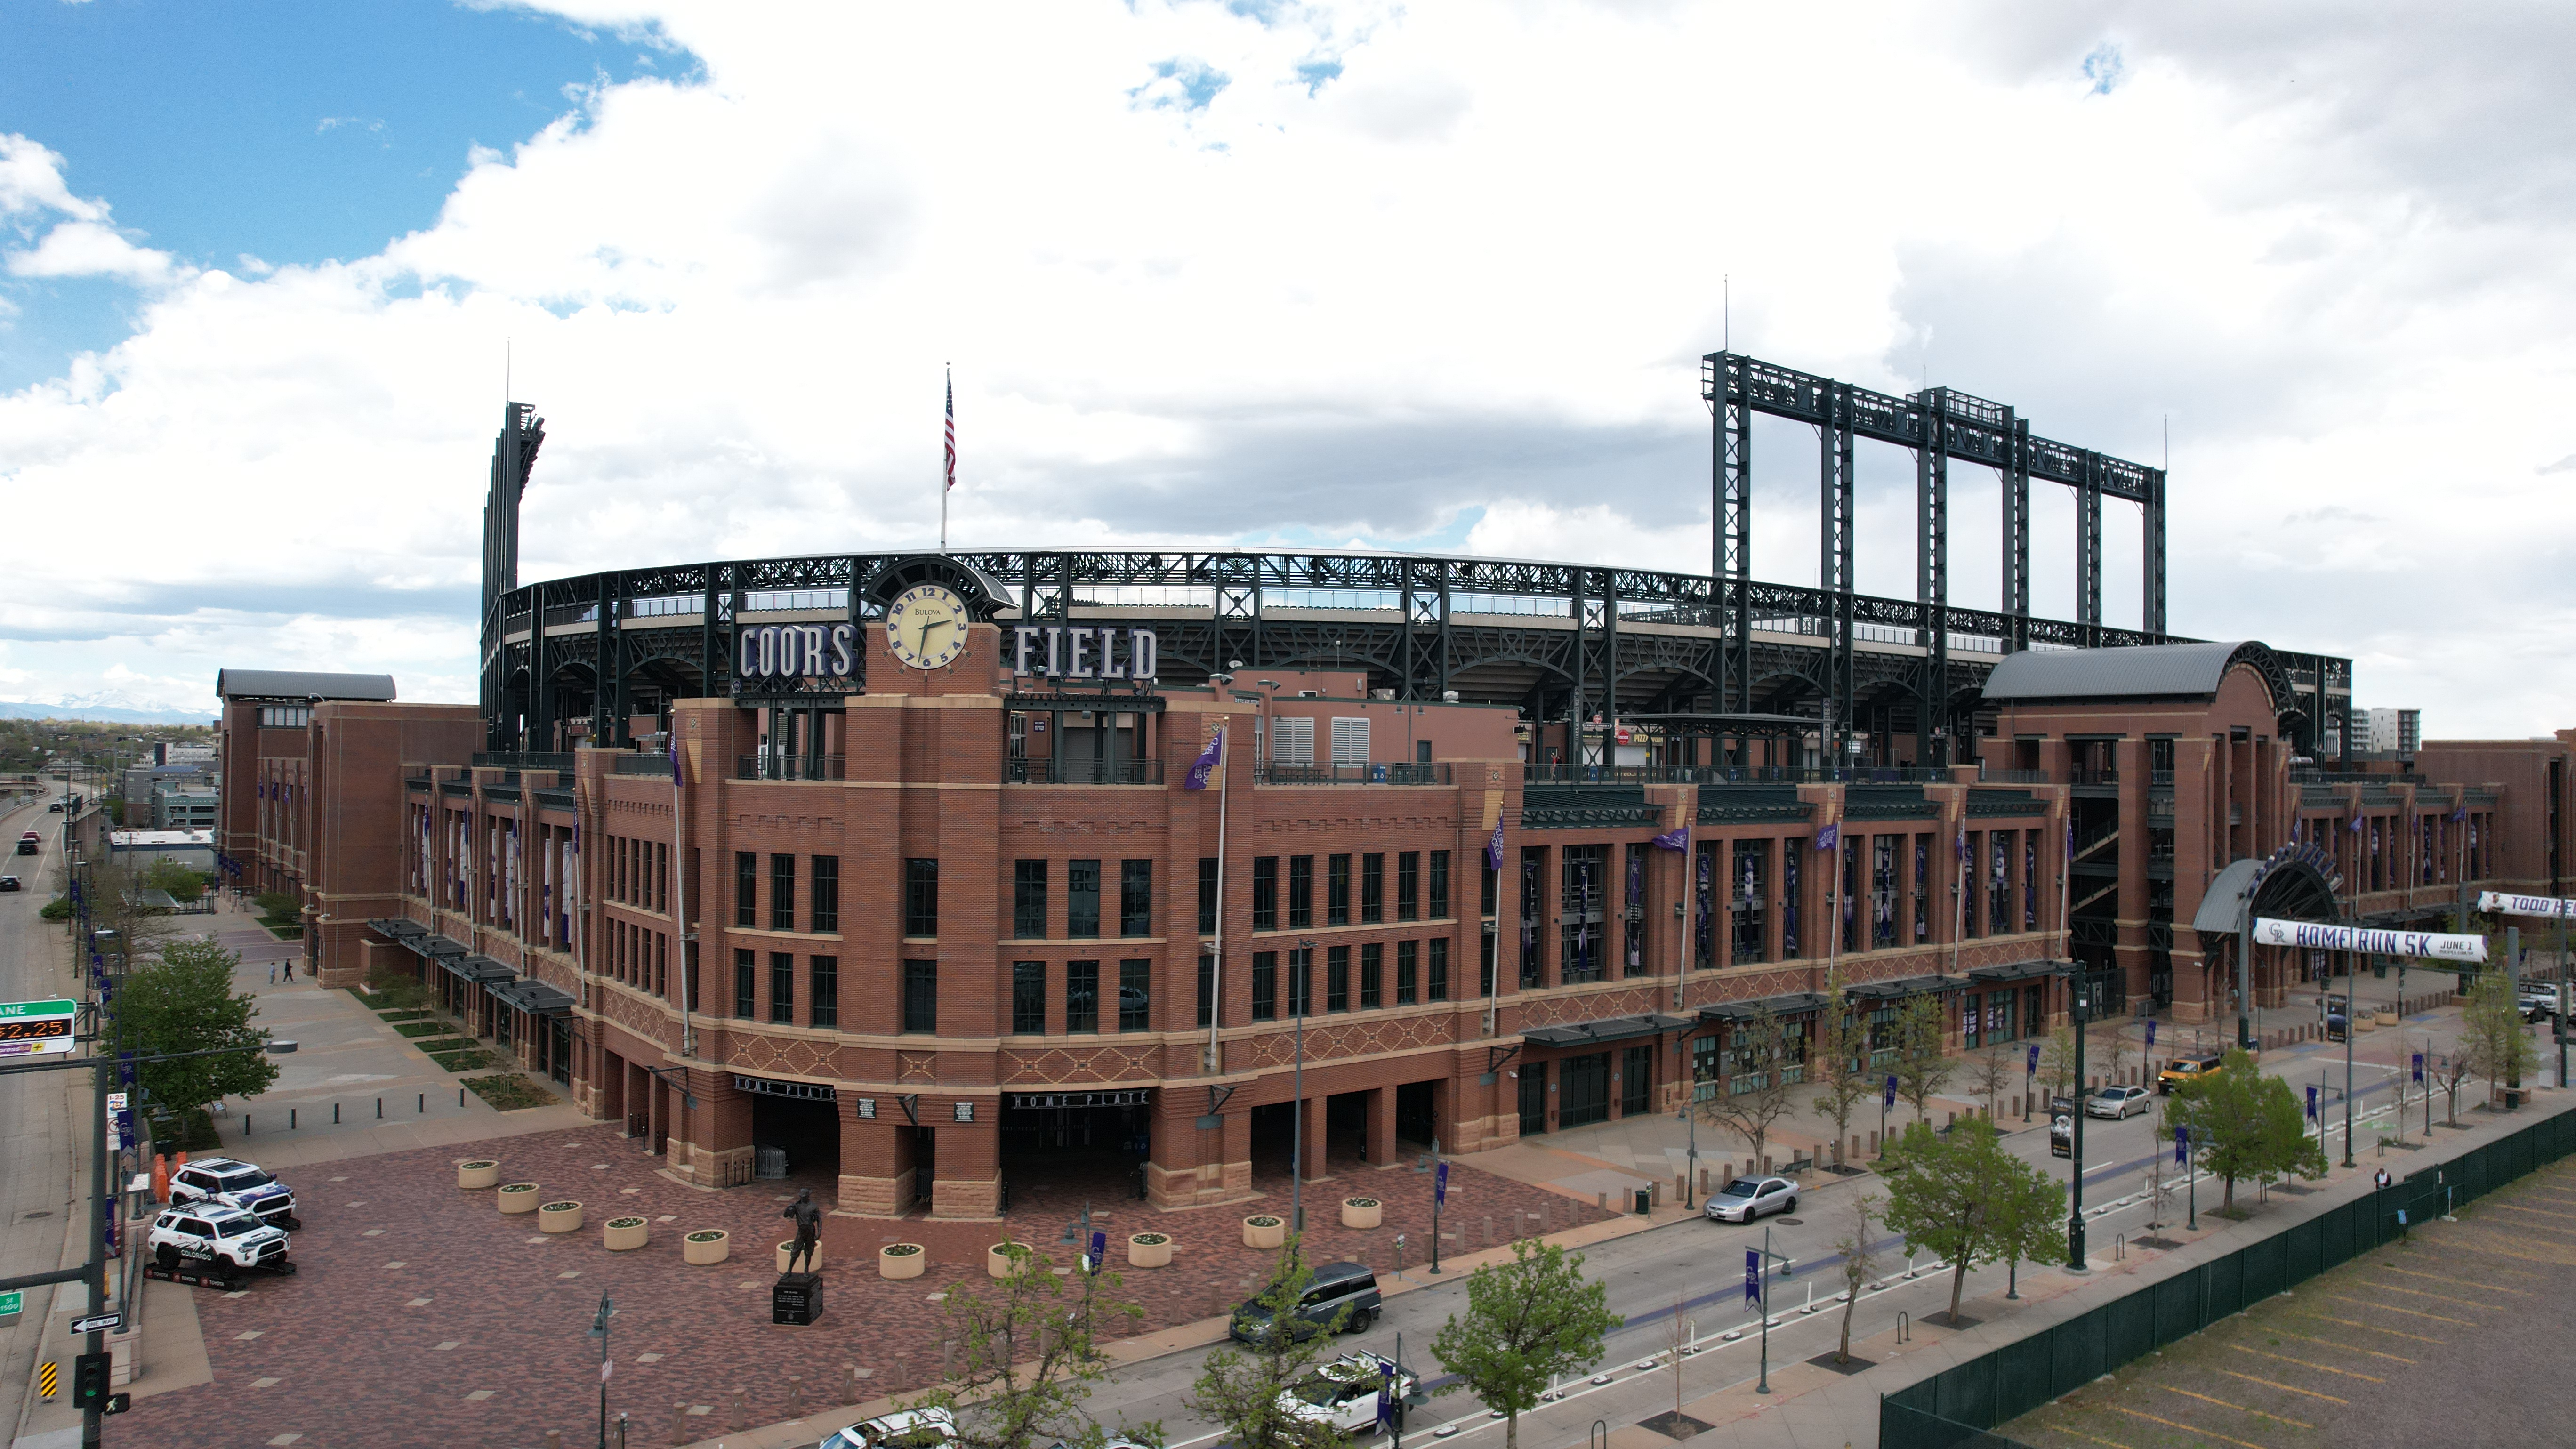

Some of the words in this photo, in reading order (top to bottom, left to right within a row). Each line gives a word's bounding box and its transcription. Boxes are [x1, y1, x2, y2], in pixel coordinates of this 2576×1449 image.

[922, 588, 935, 596] 12
[942, 592, 949, 600] 1
[905, 592, 916, 602] 11
[892, 603, 904, 615] 10
[953, 605, 962, 614] 2
[889, 623, 897, 631] 9
[958, 623, 966, 631] 3
[893, 640, 902, 649] 8
[953, 641, 961, 650] 4
[741, 624, 857, 677] COORS
[1014, 626, 1156, 680] FIELD
[905, 652, 915, 661] 7
[940, 653, 948, 662] 5
[923, 658, 931, 667] 6
[2512, 897, 2549, 912] TODD
[2297, 925, 2351, 949] HOME
[2358, 930, 2397, 953] RUN
[2405, 934, 2432, 957] 5K
[2440, 940, 2464, 950] JUNE
[2467, 942, 2472, 950] 1
[735, 1076, 771, 1093] HOME
[787, 1085, 835, 1100] PLATE
[1015, 1095, 1067, 1107] HOME
[1087, 1092, 1147, 1106] PLATE
[181, 1249, 211, 1261] COLORADO
[0, 1303, 19, 1312] 1500
